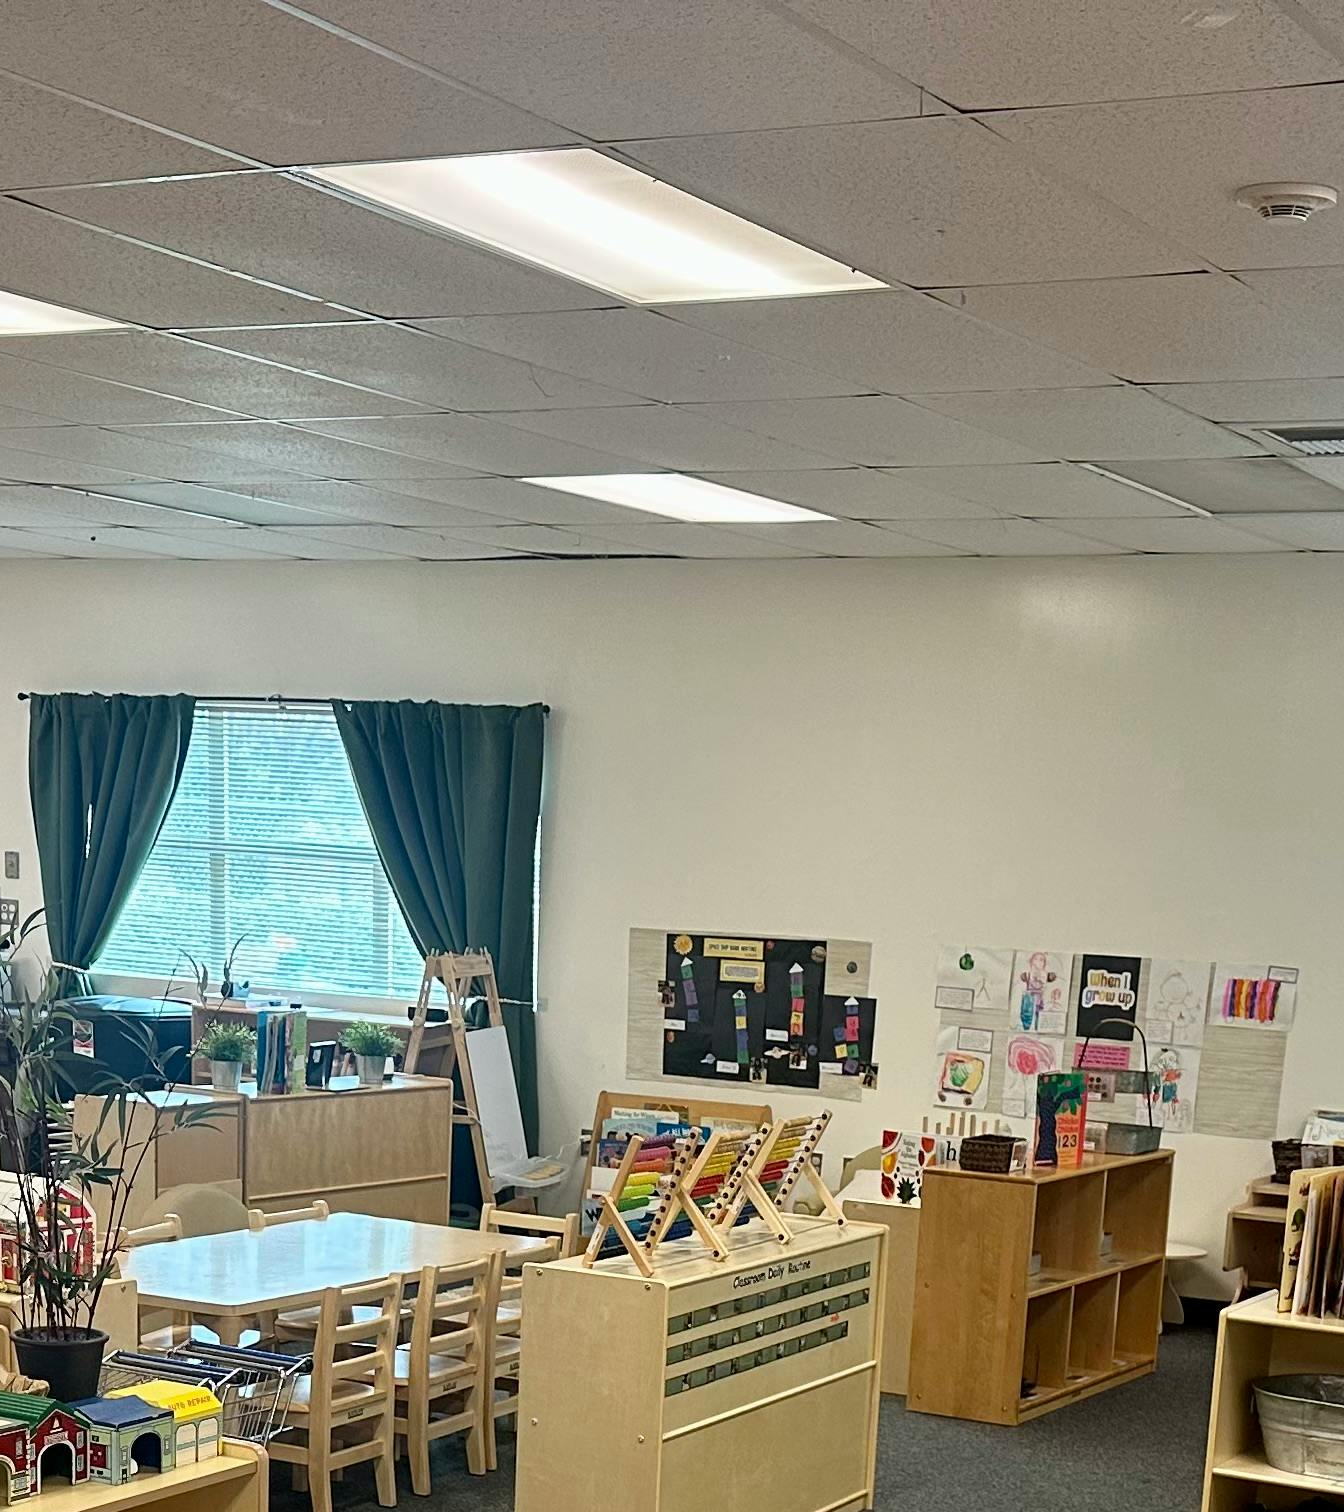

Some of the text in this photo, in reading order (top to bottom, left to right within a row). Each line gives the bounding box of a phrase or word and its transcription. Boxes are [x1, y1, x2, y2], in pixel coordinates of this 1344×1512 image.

[1089, 972, 1128, 989] When I
[1085, 990, 1133, 1007] grow up
[733, 1259, 811, 1289] Classroom Daily Routine
